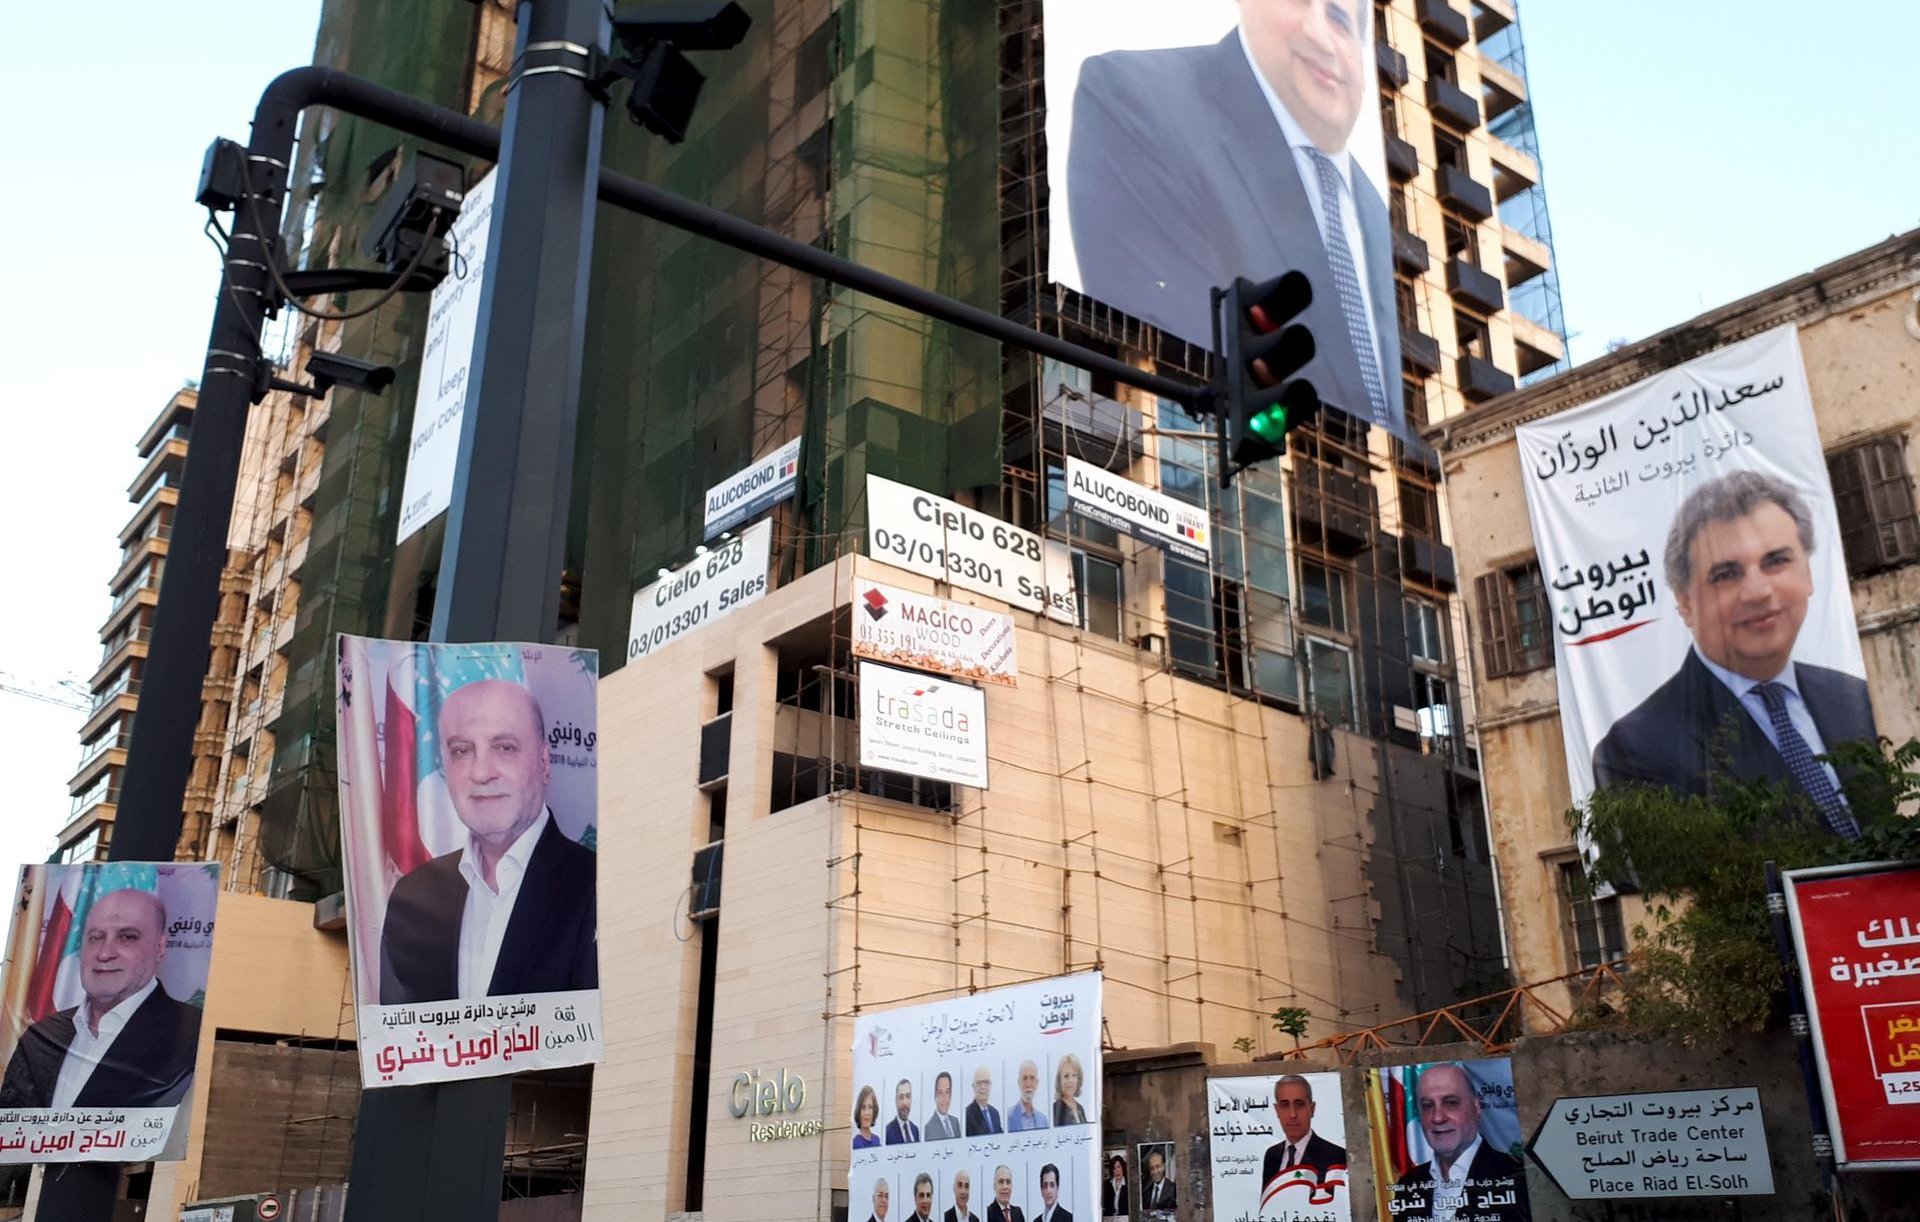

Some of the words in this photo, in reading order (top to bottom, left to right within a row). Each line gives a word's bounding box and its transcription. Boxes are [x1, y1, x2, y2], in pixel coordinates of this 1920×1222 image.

[412, 422, 434, 460] your
[438, 390, 464, 430] cool
[1638, 453, 1695, 483] بيروت
[708, 465, 775, 516] ALUCOBOND
[1073, 470, 1169, 524] ALUCOBOND
[1574, 470, 1629, 506] الثانية
[913, 496, 984, 541] Cielo
[993, 525, 1041, 562] 628
[656, 569, 701, 607] Cielo
[706, 541, 743, 579] 628
[875, 528, 1003, 588] 03/013301
[1018, 575, 1075, 613] Sales
[1551, 548, 1650, 592] بيروت
[629, 601, 709, 657] 03/013301
[719, 574, 765, 611] Sales
[901, 603, 973, 635] MAGICO
[1559, 580, 1655, 635] الوطن
[860, 624, 872, 640] 03
[916, 626, 960, 648] WOOD
[877, 689, 969, 732] trasada
[548, 721, 582, 748] ونبني
[876, 716, 920, 734] Stretch
[924, 727, 970, 745] Ceilings
[511, 998, 536, 1018] مرشح
[1040, 993, 1074, 1008] بيروت
[382, 1008, 416, 1029] الثانية
[419, 1010, 460, 1026] بيروت
[1039, 1008, 1074, 1029] الوطن
[503, 1026, 539, 1061] الحاج
[376, 1030, 435, 1081] شري
[729, 1067, 806, 1118] Cielo
[95, 1110, 125, 1124] مرشح
[1564, 1101, 1633, 1125] التجاري
[1642, 1103, 1701, 1119] بيروت
[1710, 1095, 1755, 1117] مركز
[21, 1113, 49, 1124] بيروت
[77, 1112, 92, 1124] عن
[78, 1130, 126, 1153] الحاج
[750, 1119, 824, 1143] Residences
[1246, 1124, 1273, 1136] محمد
[1576, 1130, 1624, 1146] Beirut
[1631, 1128, 1678, 1143] Trade
[1687, 1126, 1745, 1141] Center
[1582, 1150, 1636, 1173] الصلح
[1642, 1149, 1688, 1168] رياض
[1696, 1147, 1747, 1163] ساحة
[1590, 1178, 1634, 1193] Place
[1643, 1176, 1678, 1191] Riad
[1686, 1174, 1748, 1190] El-Solh
[1388, 1192, 1425, 1215] شري
[1477, 1190, 1516, 1208] الحاج
